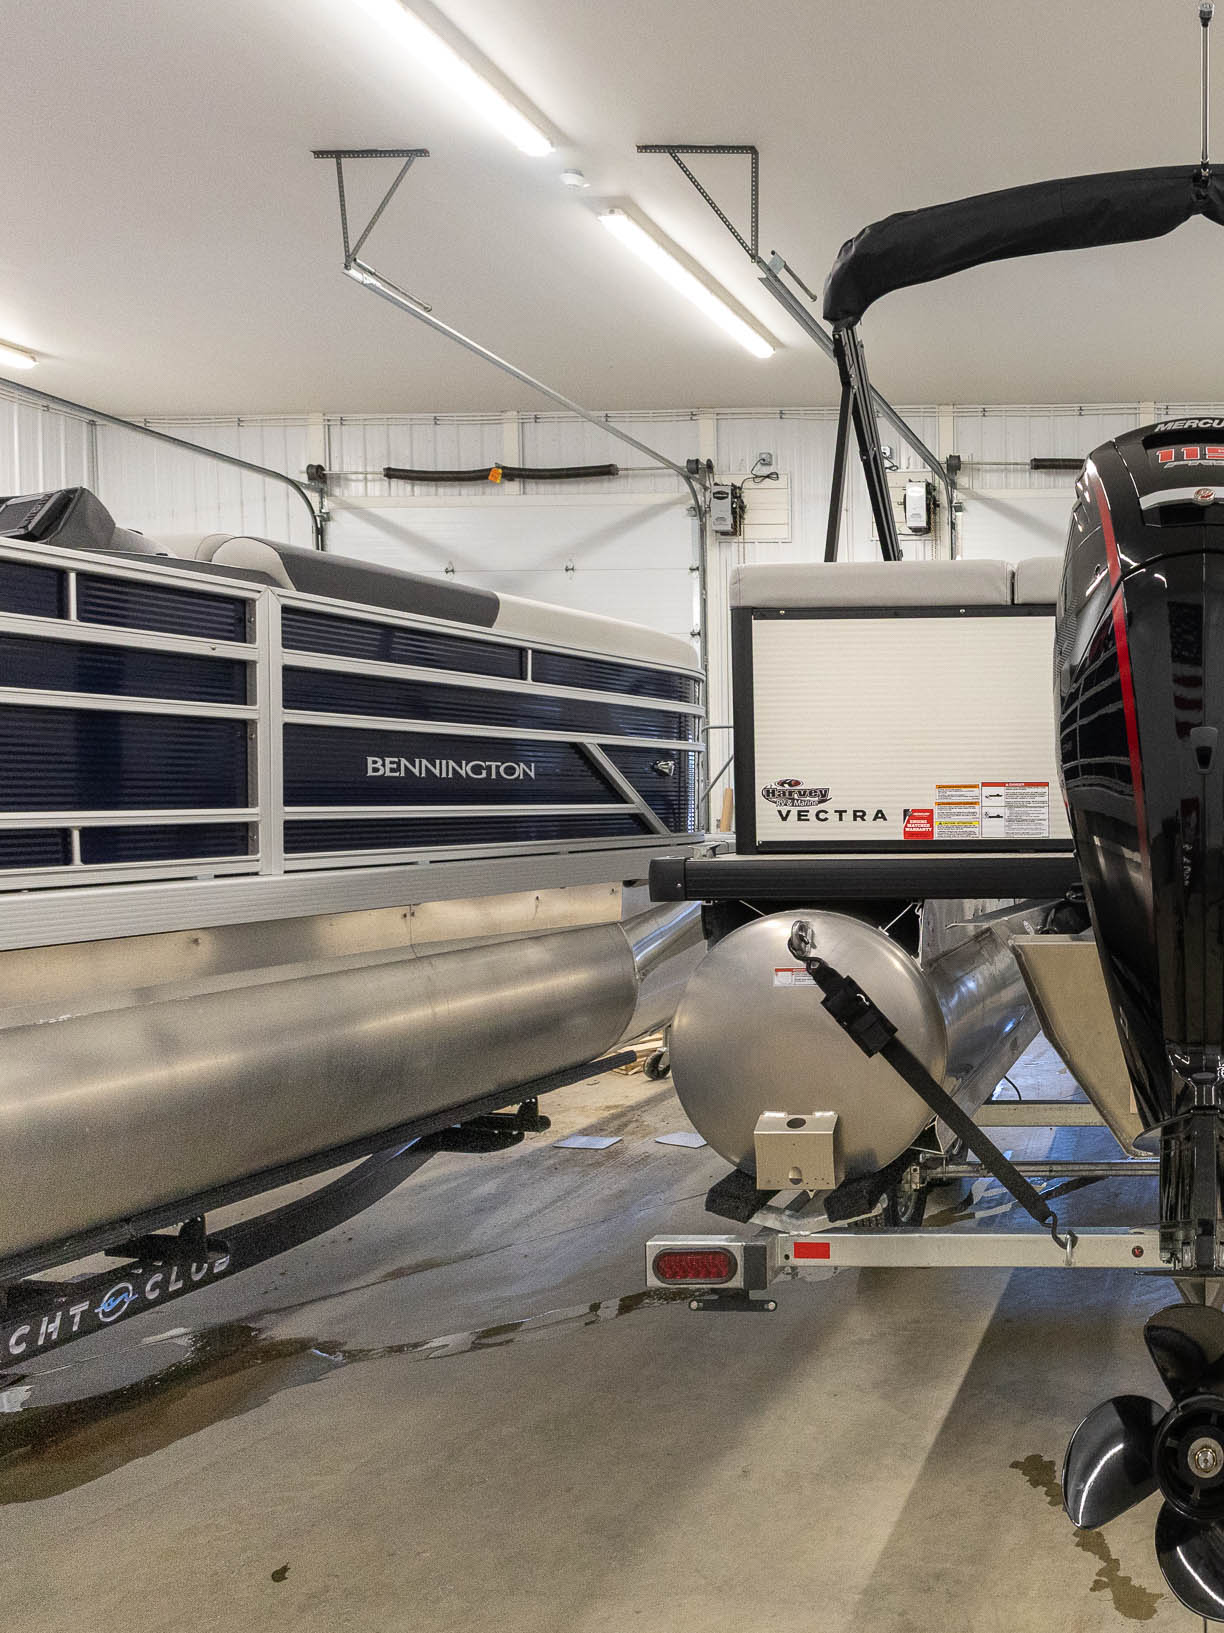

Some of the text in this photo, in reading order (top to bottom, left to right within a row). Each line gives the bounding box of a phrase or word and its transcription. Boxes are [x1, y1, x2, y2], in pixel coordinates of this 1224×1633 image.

[366, 756, 536, 780] BENNINGTON
[762, 787, 830, 800] Harvey
[777, 809, 888, 822] VECTRA
